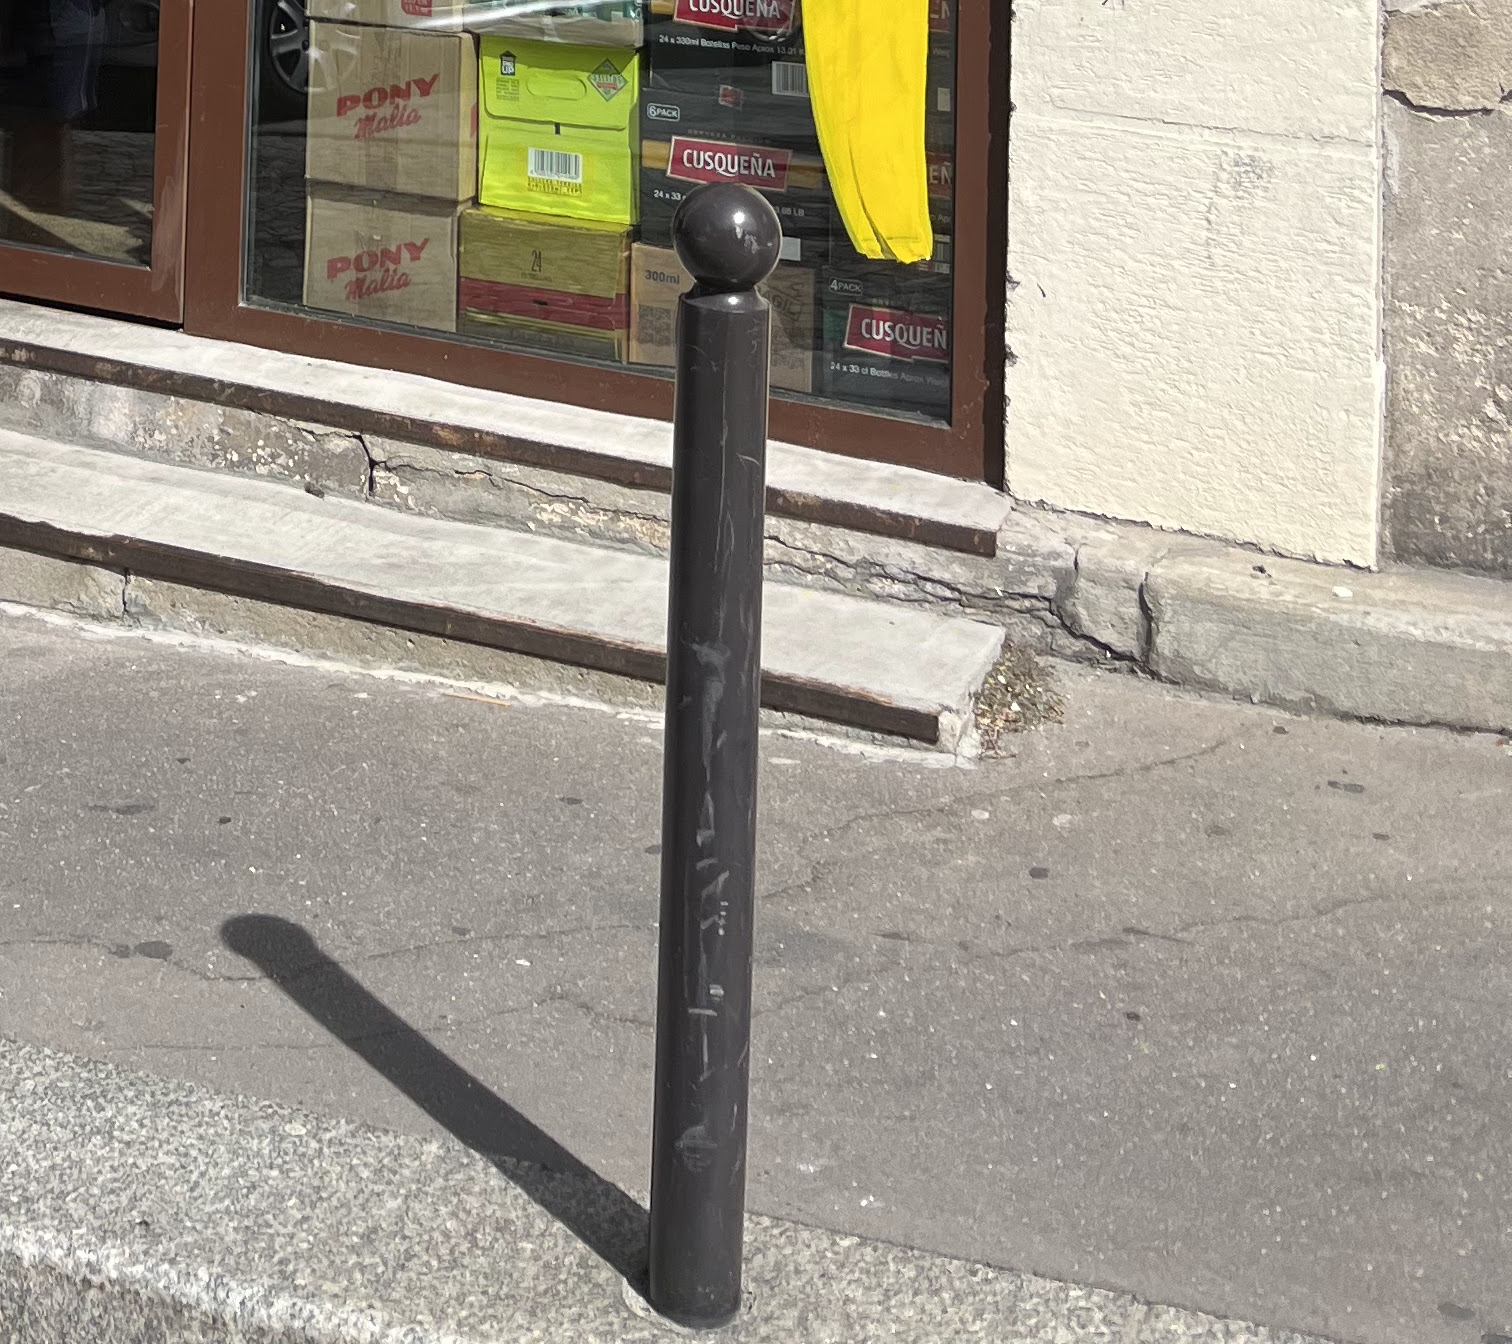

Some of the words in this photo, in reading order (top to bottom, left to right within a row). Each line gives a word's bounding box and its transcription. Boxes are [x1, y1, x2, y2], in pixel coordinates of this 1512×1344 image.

[659, 34, 670, 43] 24
[336, 73, 440, 118] PONY
[354, 103, 421, 140] Malta
[682, 148, 776, 178] CUSQUEÑA
[653, 189, 665, 199] 24
[671, 191, 681, 200] 33
[327, 238, 430, 280] PONY
[531, 249, 542, 273] 24
[345, 267, 412, 301] Malta
[644, 269, 681, 285] 300ml
[861, 317, 947, 350] CUSQUEÑ
[849, 364, 860, 374] 33
